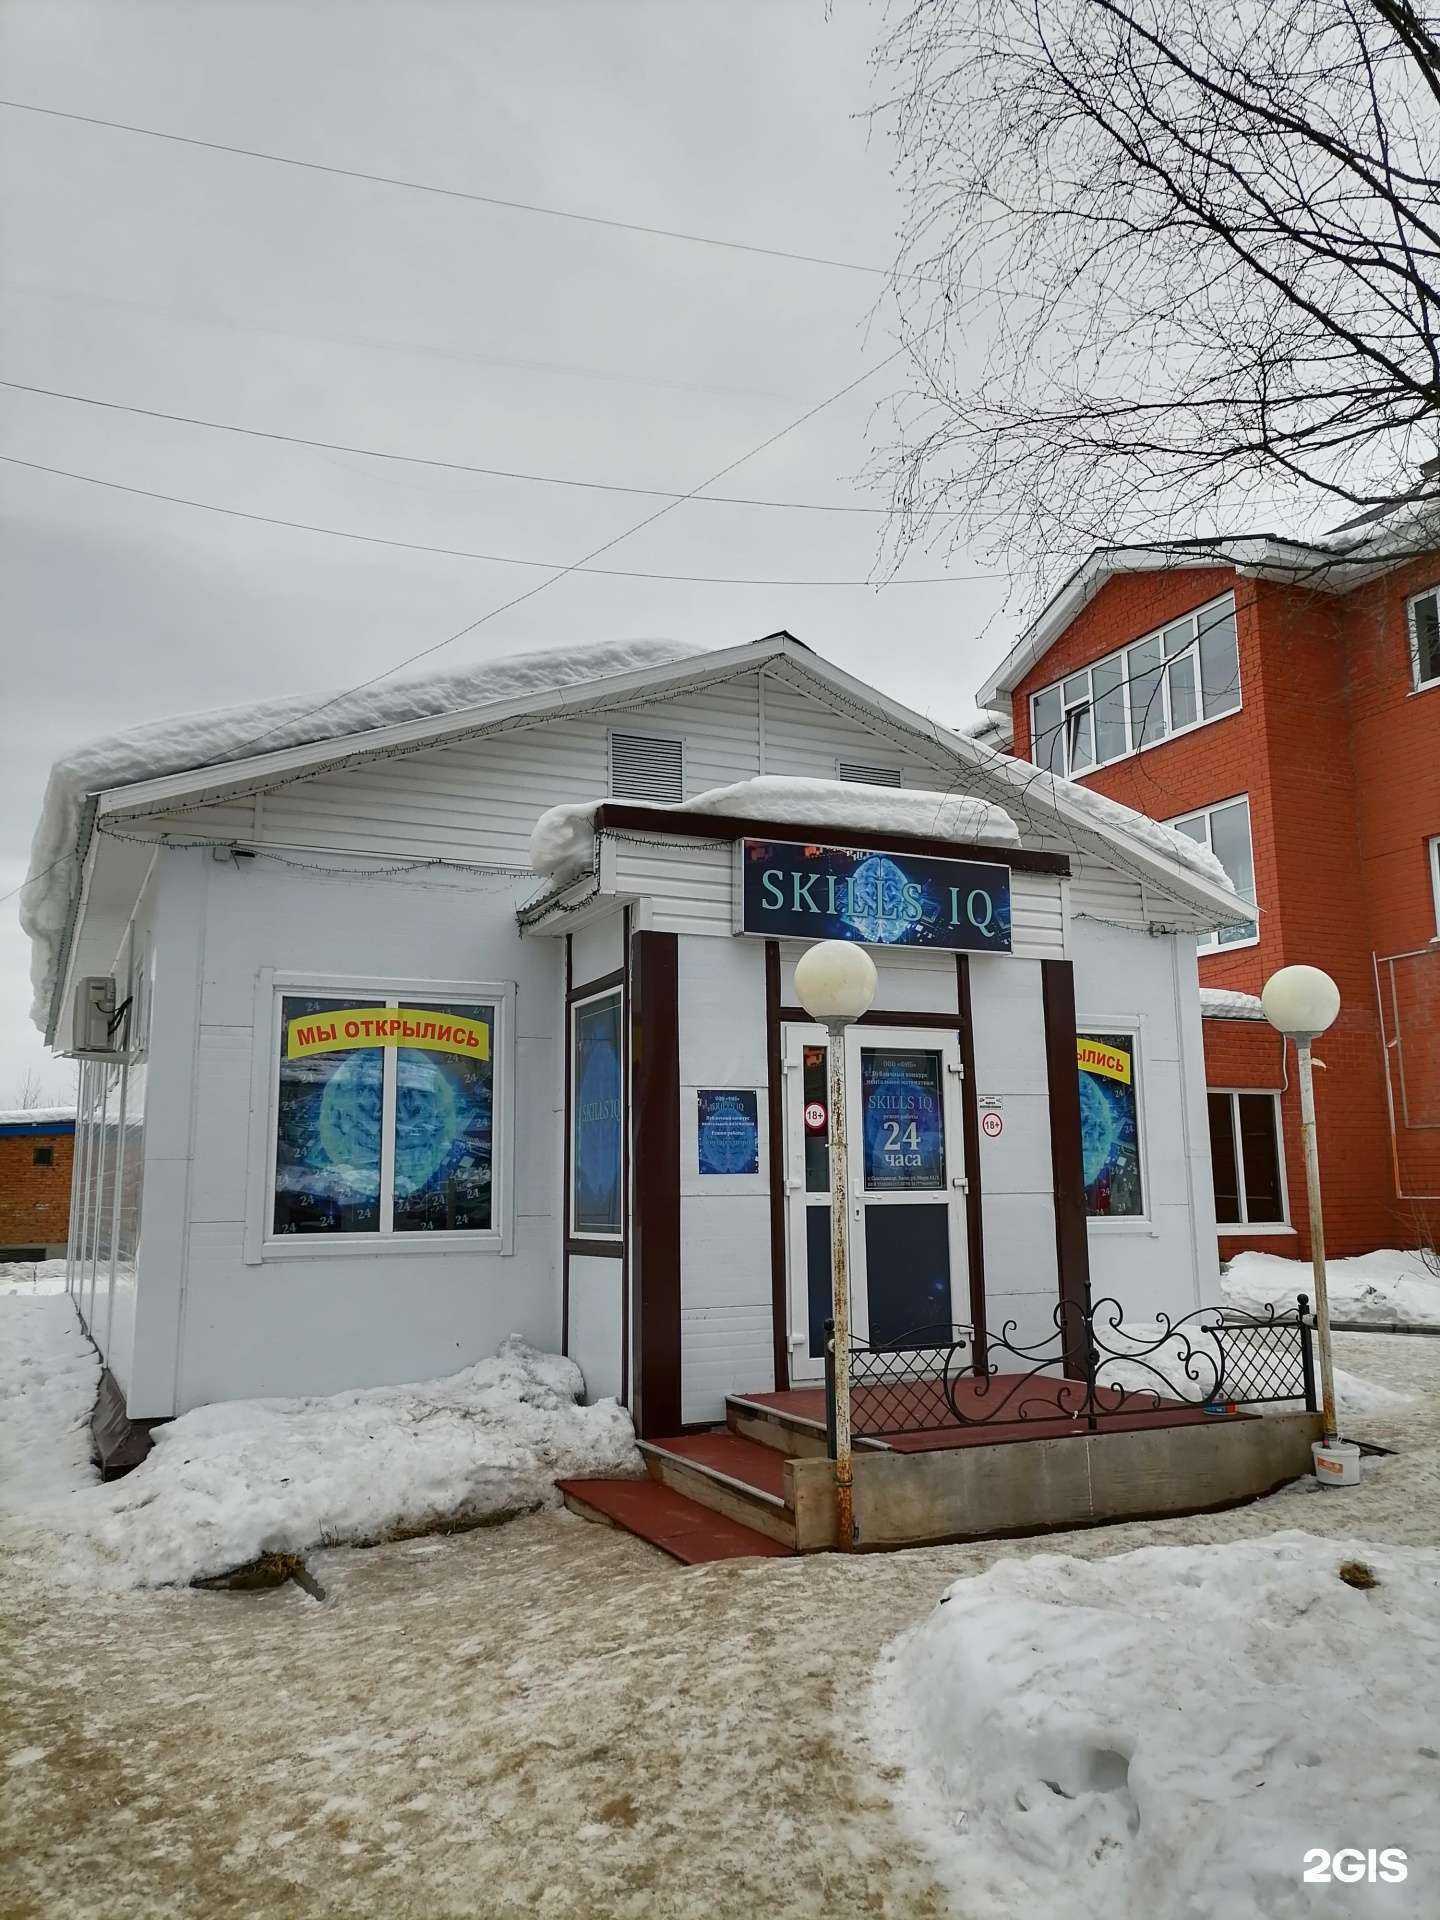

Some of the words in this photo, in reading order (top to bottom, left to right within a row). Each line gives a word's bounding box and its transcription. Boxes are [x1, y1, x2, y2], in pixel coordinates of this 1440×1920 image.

[761, 869, 923, 922] SKILLS
[949, 886, 995, 938] IQ
[297, 1023, 337, 1046] МЫ
[344, 1019, 480, 1048] ОТКРЫЛИСЬ
[464, 1073, 478, 1084] 24
[868, 1095, 915, 1110] SKILLS
[919, 1096, 934, 1113] IQ
[807, 1110, 823, 1120] 18+
[985, 1120, 1000, 1130] 18+
[883, 1121, 921, 1151] 24
[885, 1154, 922, 1167] часа
[467, 1189, 480, 1199] 24
[300, 1195, 314, 1206] 24
[357, 1208, 372, 1219] 24
[320, 1215, 336, 1227] 24
[455, 1214, 469, 1225] 24
[281, 1222, 297, 1234] 24
